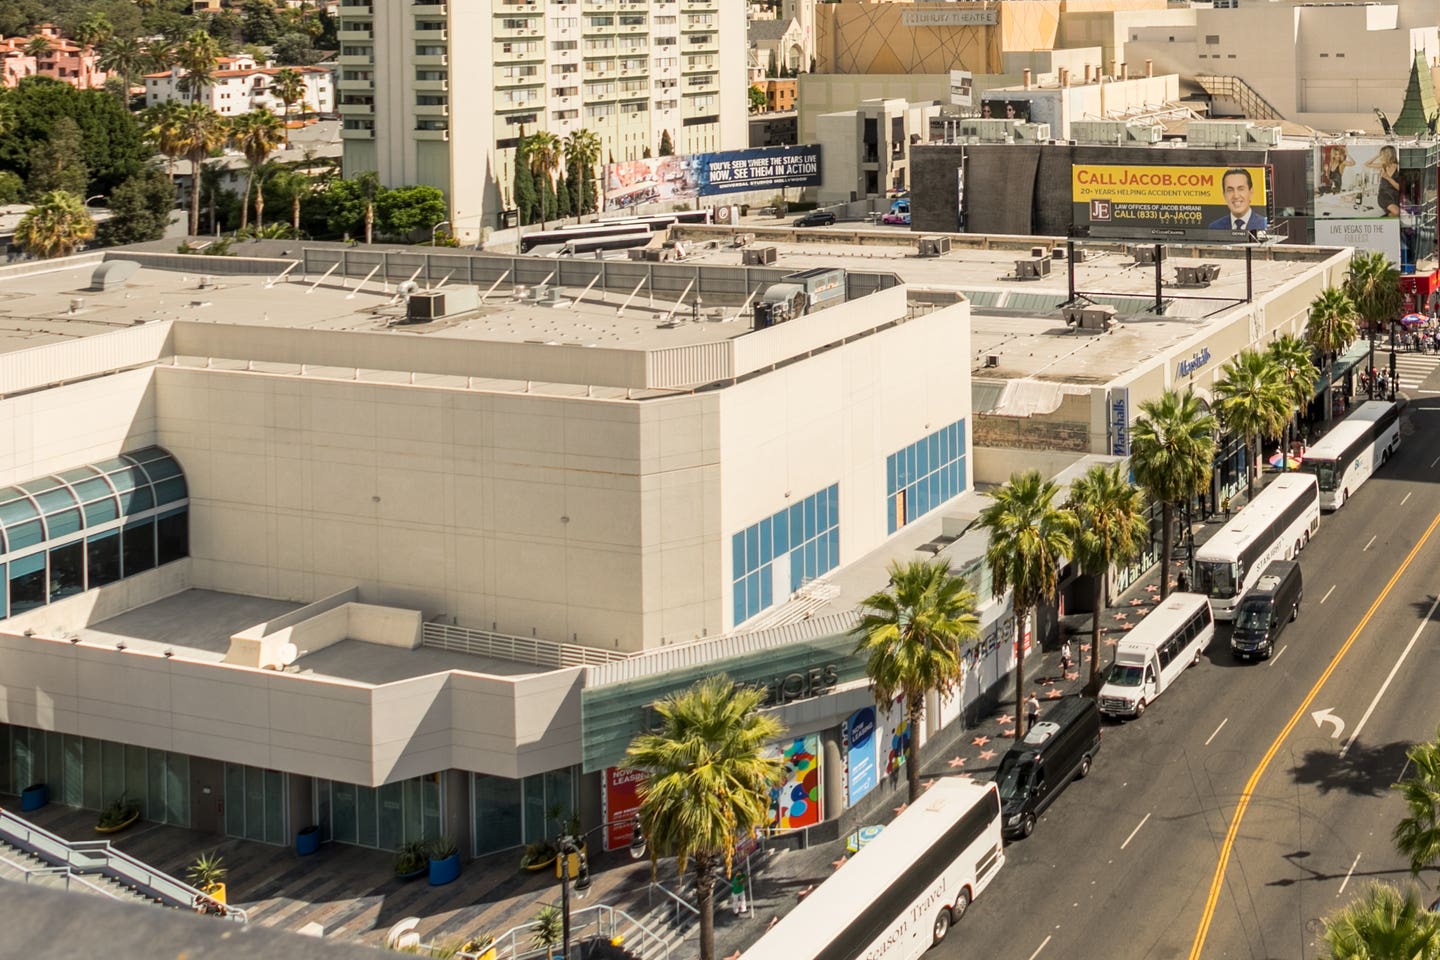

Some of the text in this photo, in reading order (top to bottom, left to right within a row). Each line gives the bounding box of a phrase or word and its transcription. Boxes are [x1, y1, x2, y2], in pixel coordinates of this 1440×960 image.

[953, 13, 992, 22] THEATRE
[709, 155, 817, 171] YOU'VE SEEN WHERE THE STARS LIVE
[710, 163, 817, 181] NOW, SEE THEM IN ACTION
[1114, 210, 1202, 220] CALL (833) LA-JACOB
[1330, 224, 1384, 234] LIVE VEGAS TO THE
[1113, 399, 1125, 456] Marshalls
[851, 722, 873, 742] LEASING
[853, 721, 864, 733] NOW
[613, 769, 633, 778] NOW
[911, 877, 946, 922] Travel
